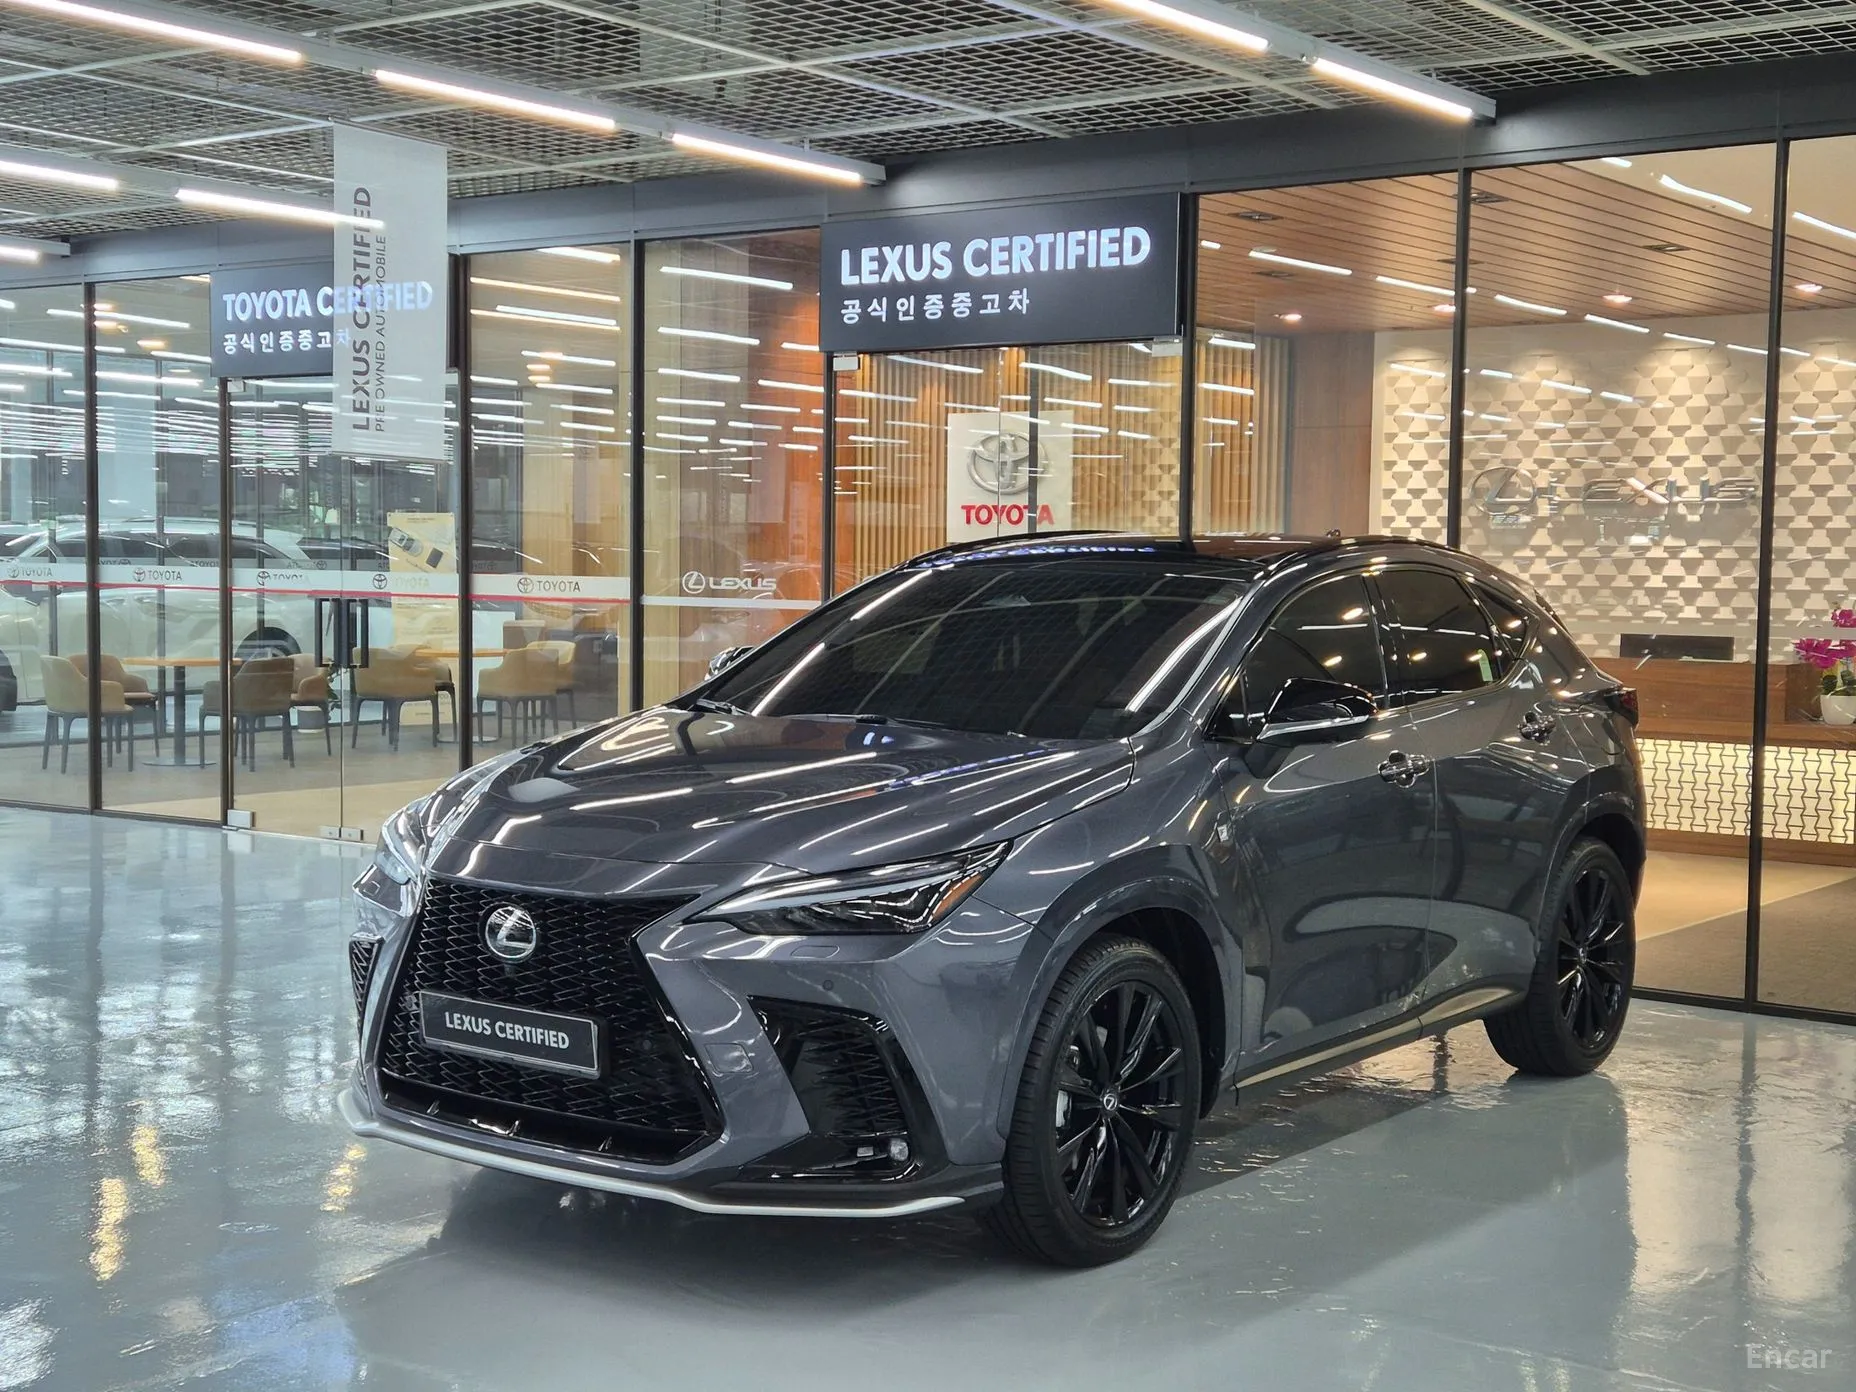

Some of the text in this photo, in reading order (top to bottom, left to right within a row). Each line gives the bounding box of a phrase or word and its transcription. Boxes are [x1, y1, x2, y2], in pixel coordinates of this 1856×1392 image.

[841, 226, 1151, 285] LEXUS CERTIFIED
[223, 280, 433, 321] TOYOTA CERTIFIED
[841, 287, 1030, 324] 공식인증중고차
[352, 340, 370, 431] LEXUS
[375, 341, 385, 400] OWNED
[961, 504, 1055, 526] TOYOA
[148, 570, 182, 581] TOYOTA
[536, 580, 581, 593] TOYOTA
[708, 577, 777, 591] LEXUS
[445, 1011, 570, 1049] LEXUS CERTIFIED
